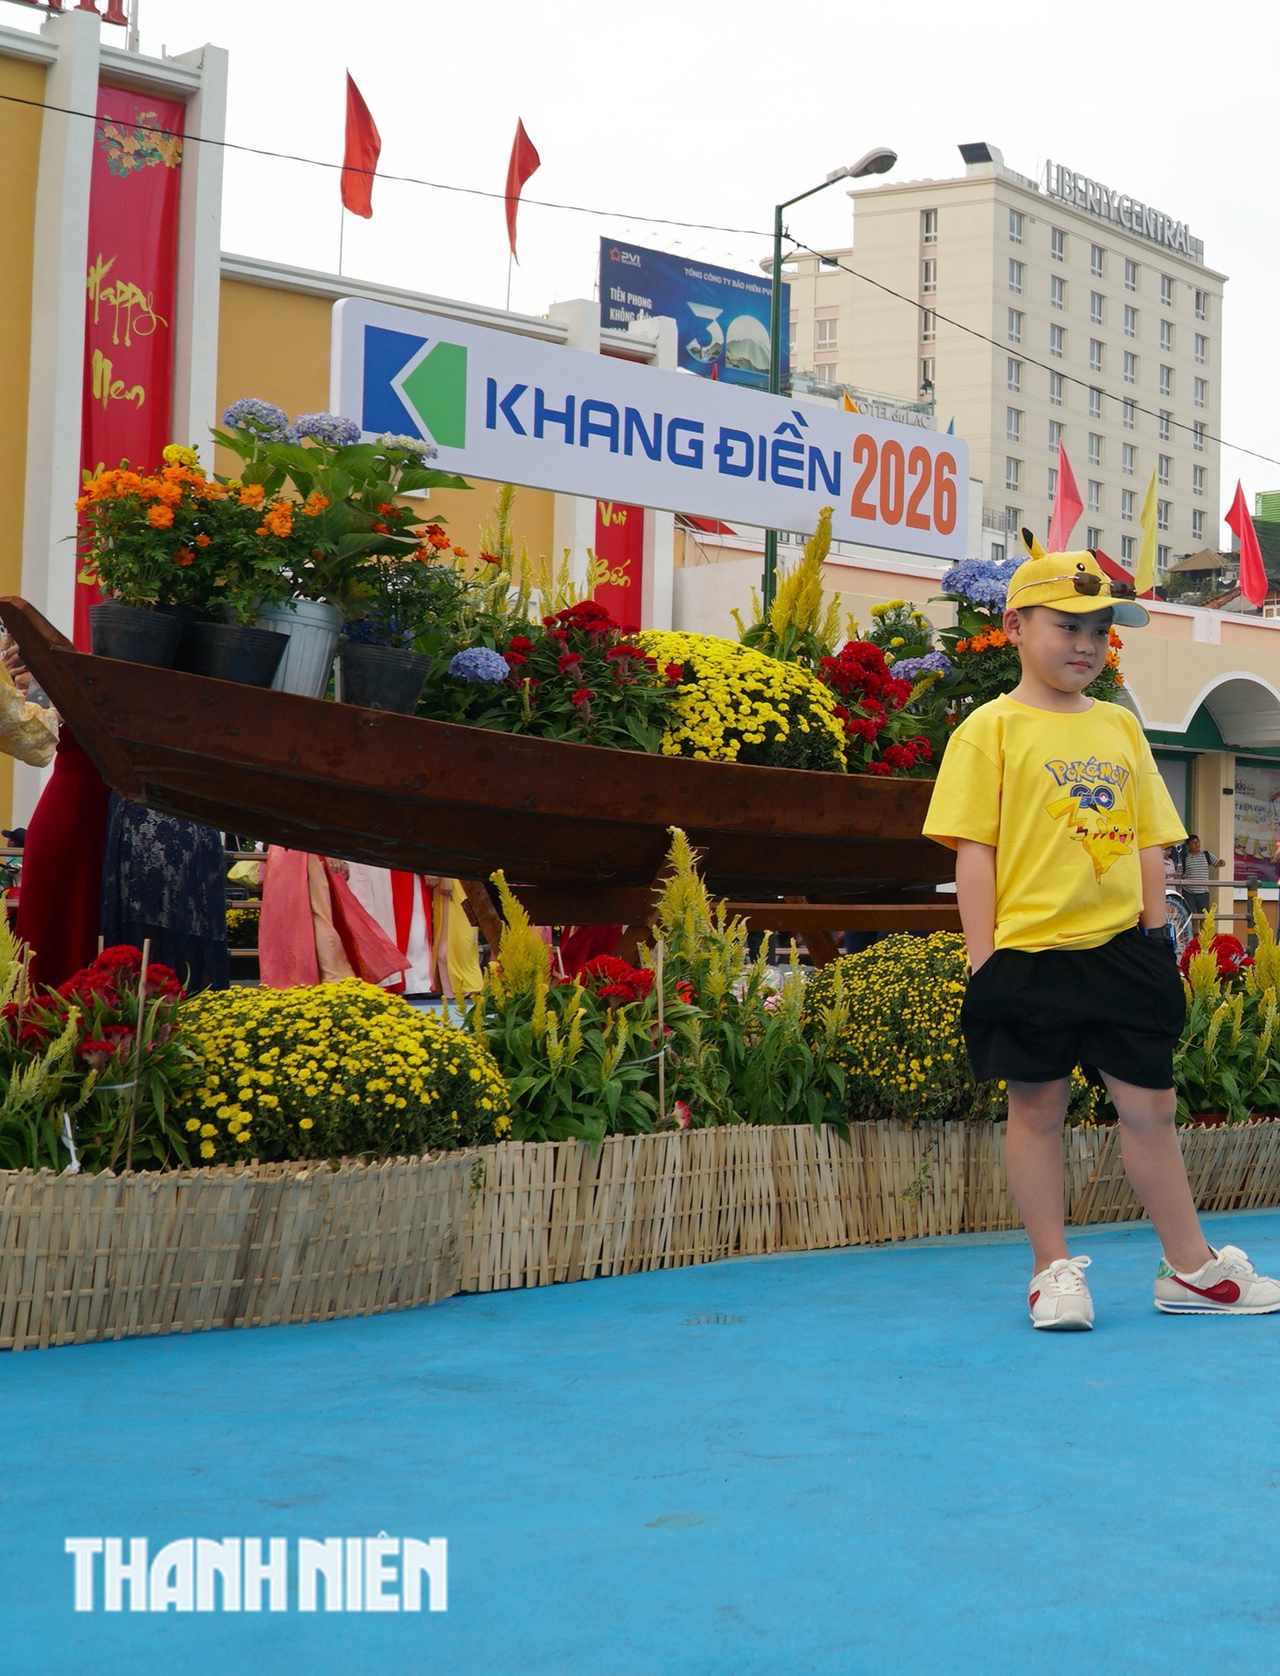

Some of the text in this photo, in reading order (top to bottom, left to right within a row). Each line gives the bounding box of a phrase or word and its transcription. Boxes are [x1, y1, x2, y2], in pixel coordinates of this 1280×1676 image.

[1046, 159, 1195, 256] LIBERTY CENTRAL
[621, 251, 640, 263] PVI
[703, 273, 722, 284] CÔNG
[722, 278, 731, 286] TY
[86, 252, 168, 347] Happy
[627, 292, 652, 310] PHONG
[609, 306, 635, 323] KHÔNG
[686, 301, 771, 374] 30
[906, 411, 931, 429] LAC
[485, 377, 957, 536] KHANG ĐIỀN 2026
[598, 501, 627, 527] Vui
[1069, 784, 1115, 811] GO
